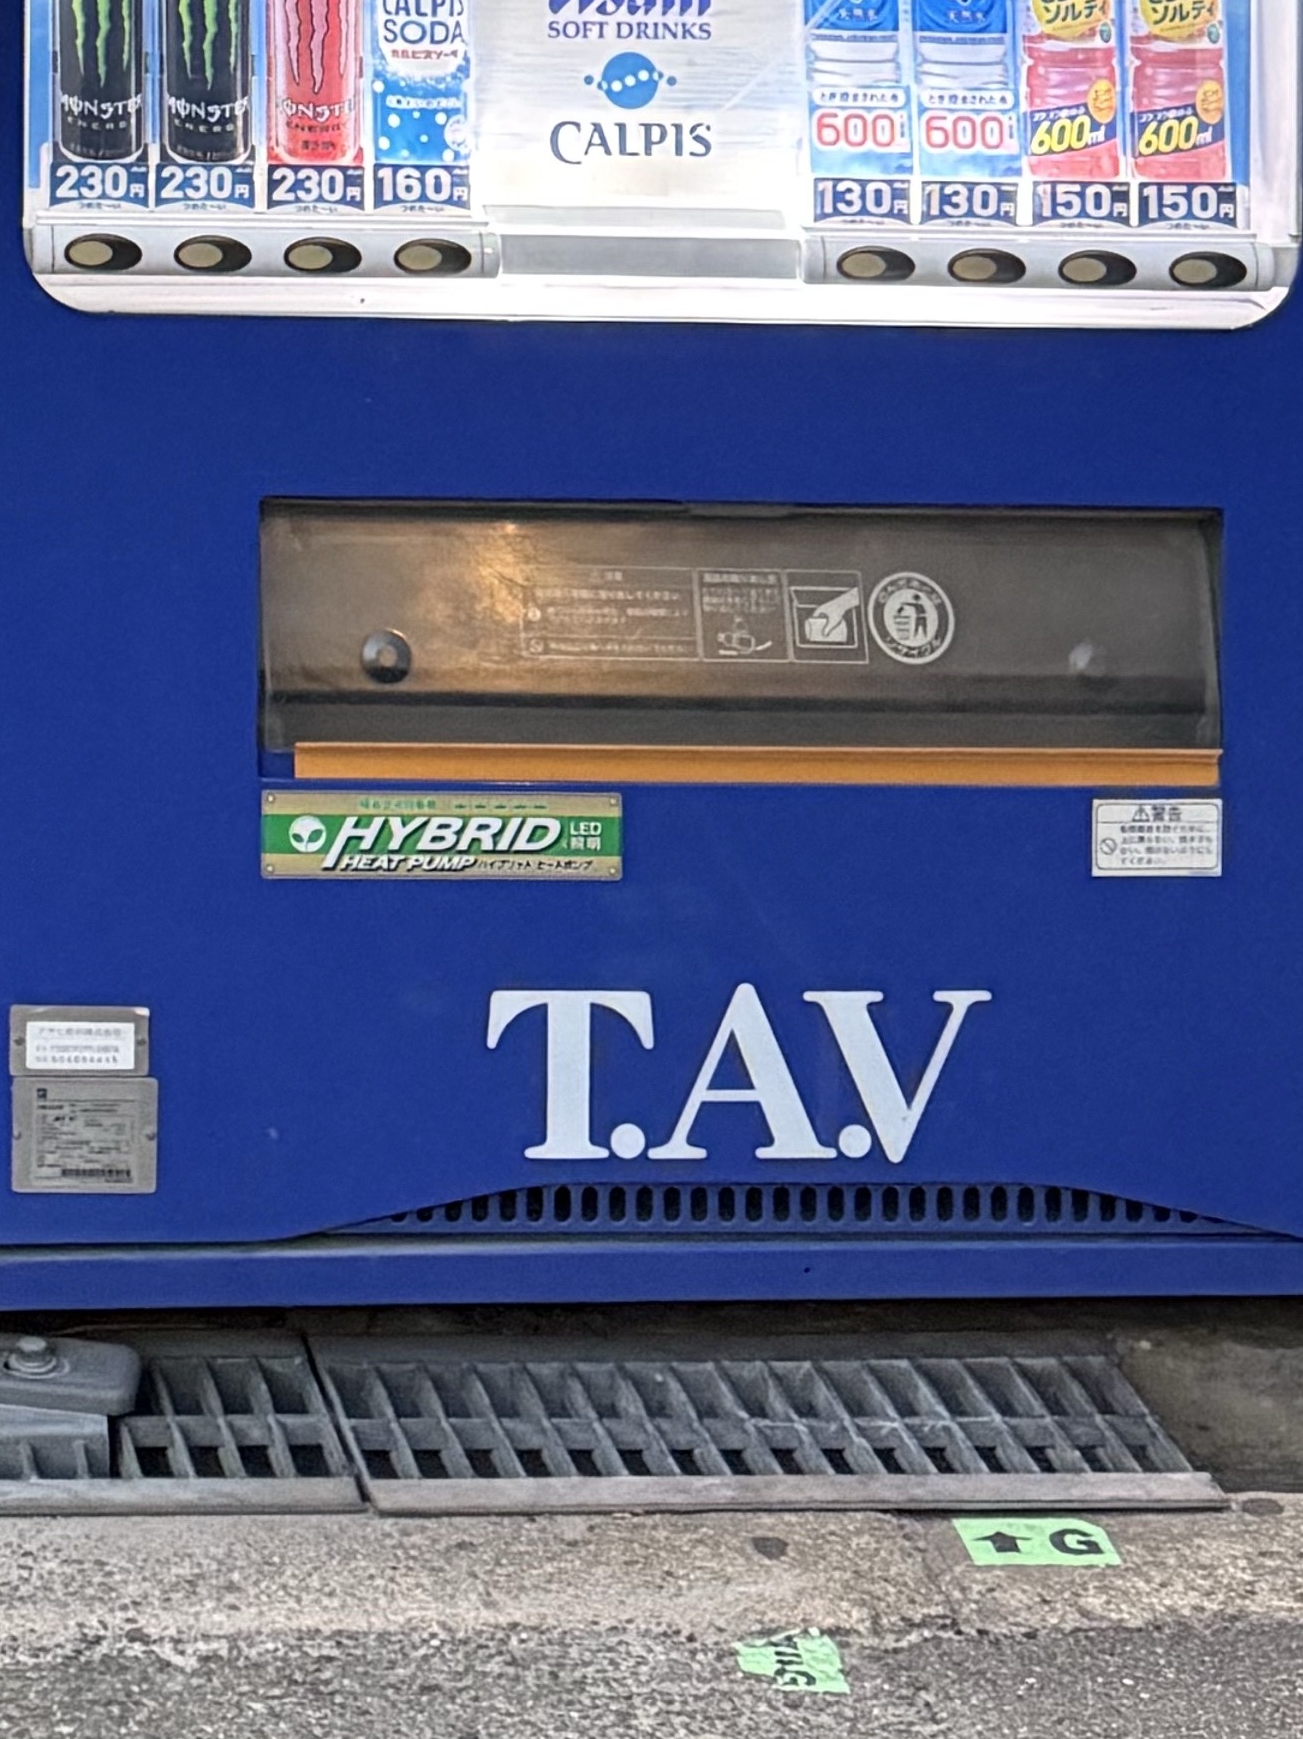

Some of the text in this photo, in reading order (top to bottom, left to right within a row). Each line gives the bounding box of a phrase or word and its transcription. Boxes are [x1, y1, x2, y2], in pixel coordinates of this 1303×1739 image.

[1042, 1, 1107, 25] ソルティ
[1149, 1, 1215, 26] ソルティ
[383, 18, 466, 46] SODA
[547, 20, 713, 41] SOFT DRINKS
[549, 120, 713, 165] CALPIS
[816, 112, 896, 148] 600
[924, 115, 1004, 150] 600
[1030, 114, 1106, 156] 600ml
[1138, 115, 1214, 156] 600ml
[55, 165, 145, 199] 230円
[160, 166, 250, 199] 230円
[271, 167, 362, 202] 230円
[377, 167, 469, 202] 160円
[817, 181, 908, 215] 130円
[924, 183, 1015, 218] 130円
[1037, 183, 1127, 218] 150円
[1143, 185, 1235, 220] 150円
[569, 821, 603, 837] LED
[1152, 805, 1183, 822] 警告
[322, 815, 562, 871] HYBRID
[569, 836, 602, 851] 照明
[341, 854, 405, 872] HEAT
[407, 855, 477, 872] PUMP
[486, 982, 993, 1163] T.A.V
[1048, 1527, 1105, 1556] G
